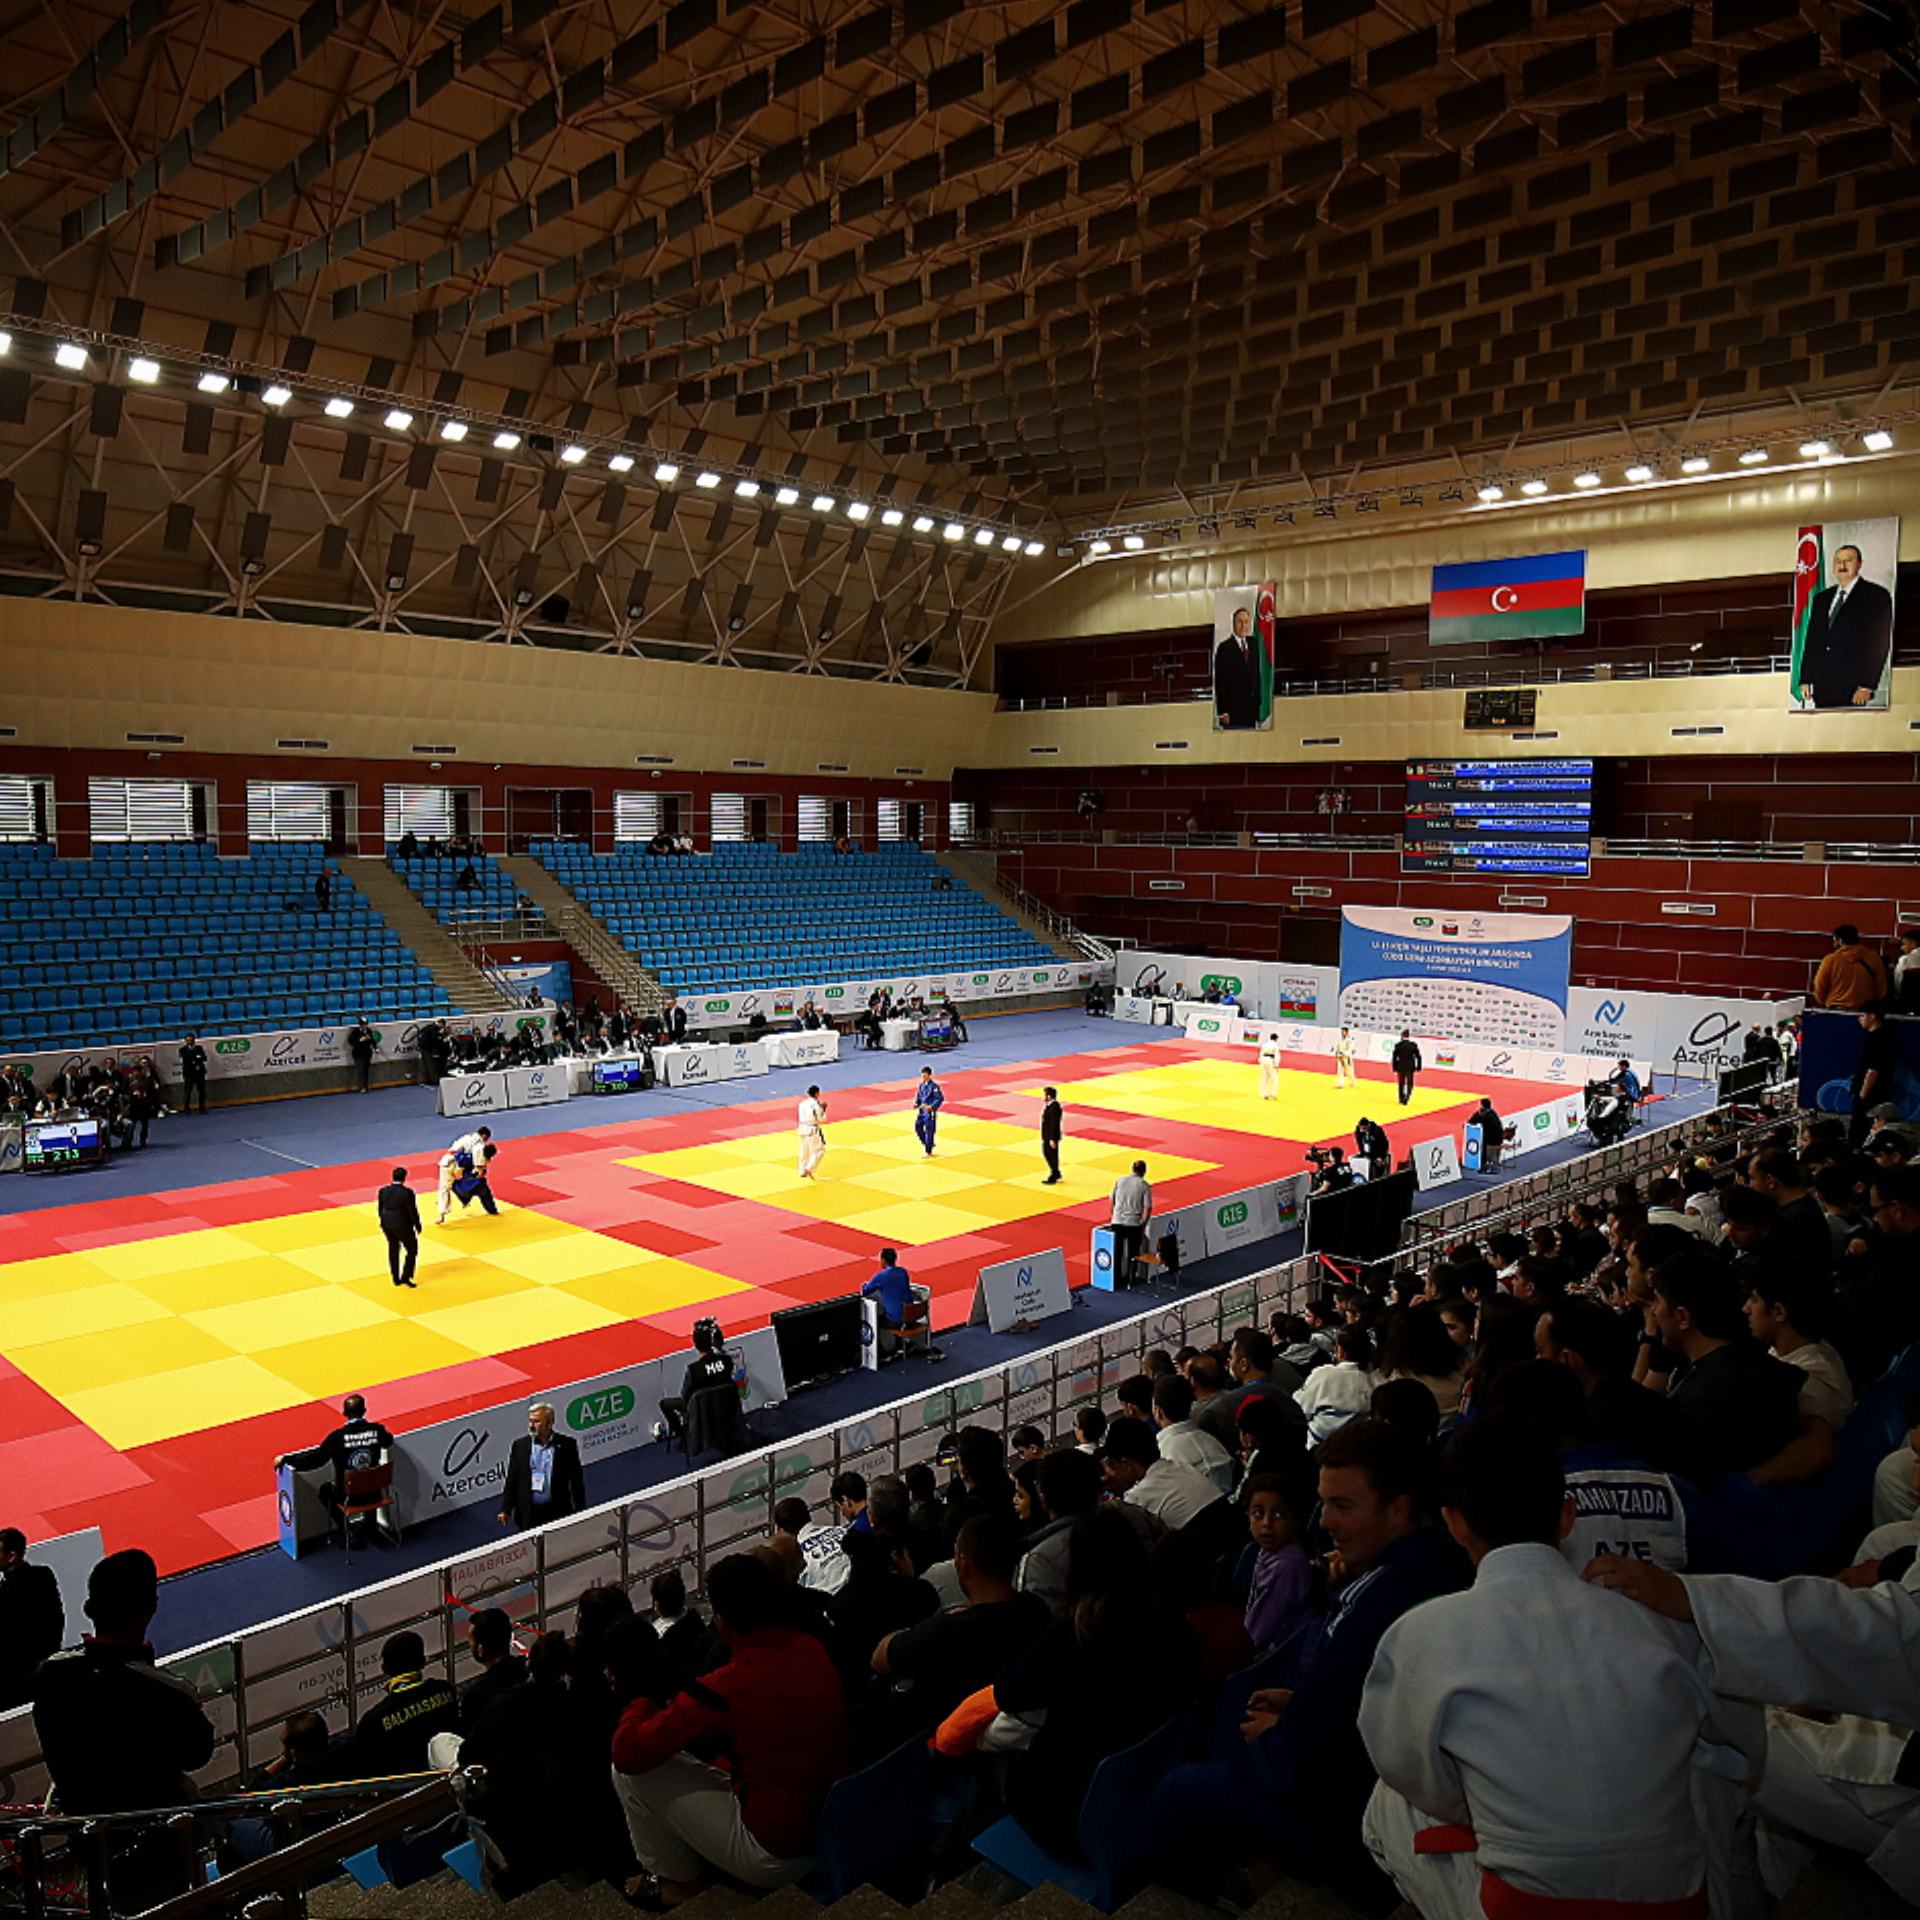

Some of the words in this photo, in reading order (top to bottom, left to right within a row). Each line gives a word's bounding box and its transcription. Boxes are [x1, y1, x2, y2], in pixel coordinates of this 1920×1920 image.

[221, 1041, 247, 1053] AZE
[1672, 1045, 1741, 1068] Azerce
[580, 1391, 625, 1425] AZE
[432, 1461, 506, 1502] Azercell
